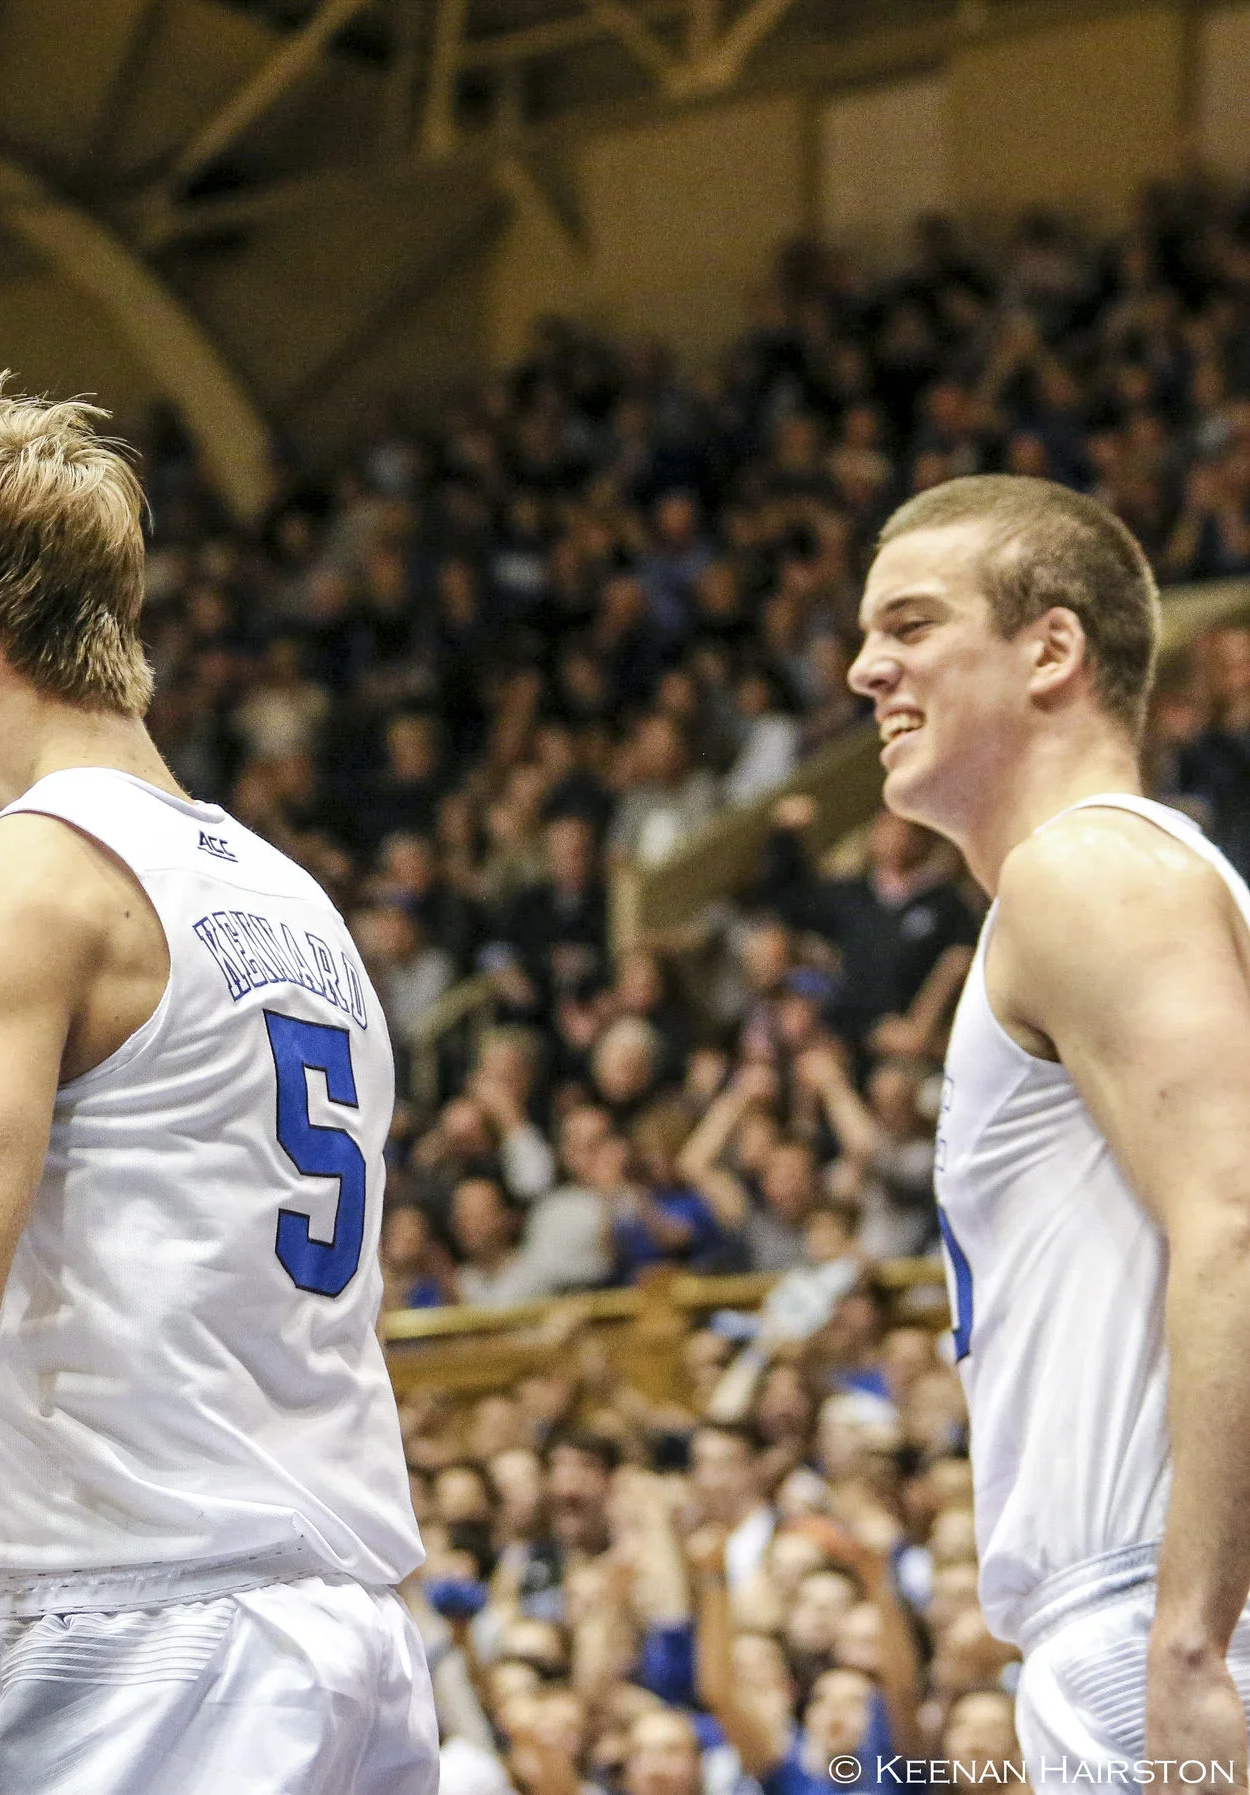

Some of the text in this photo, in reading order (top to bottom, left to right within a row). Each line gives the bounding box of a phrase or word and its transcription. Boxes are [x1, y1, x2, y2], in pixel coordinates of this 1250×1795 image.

[198, 830, 236, 859] ACC
[192, 910, 368, 1031] KENNARD
[263, 1009, 366, 1299] 5
